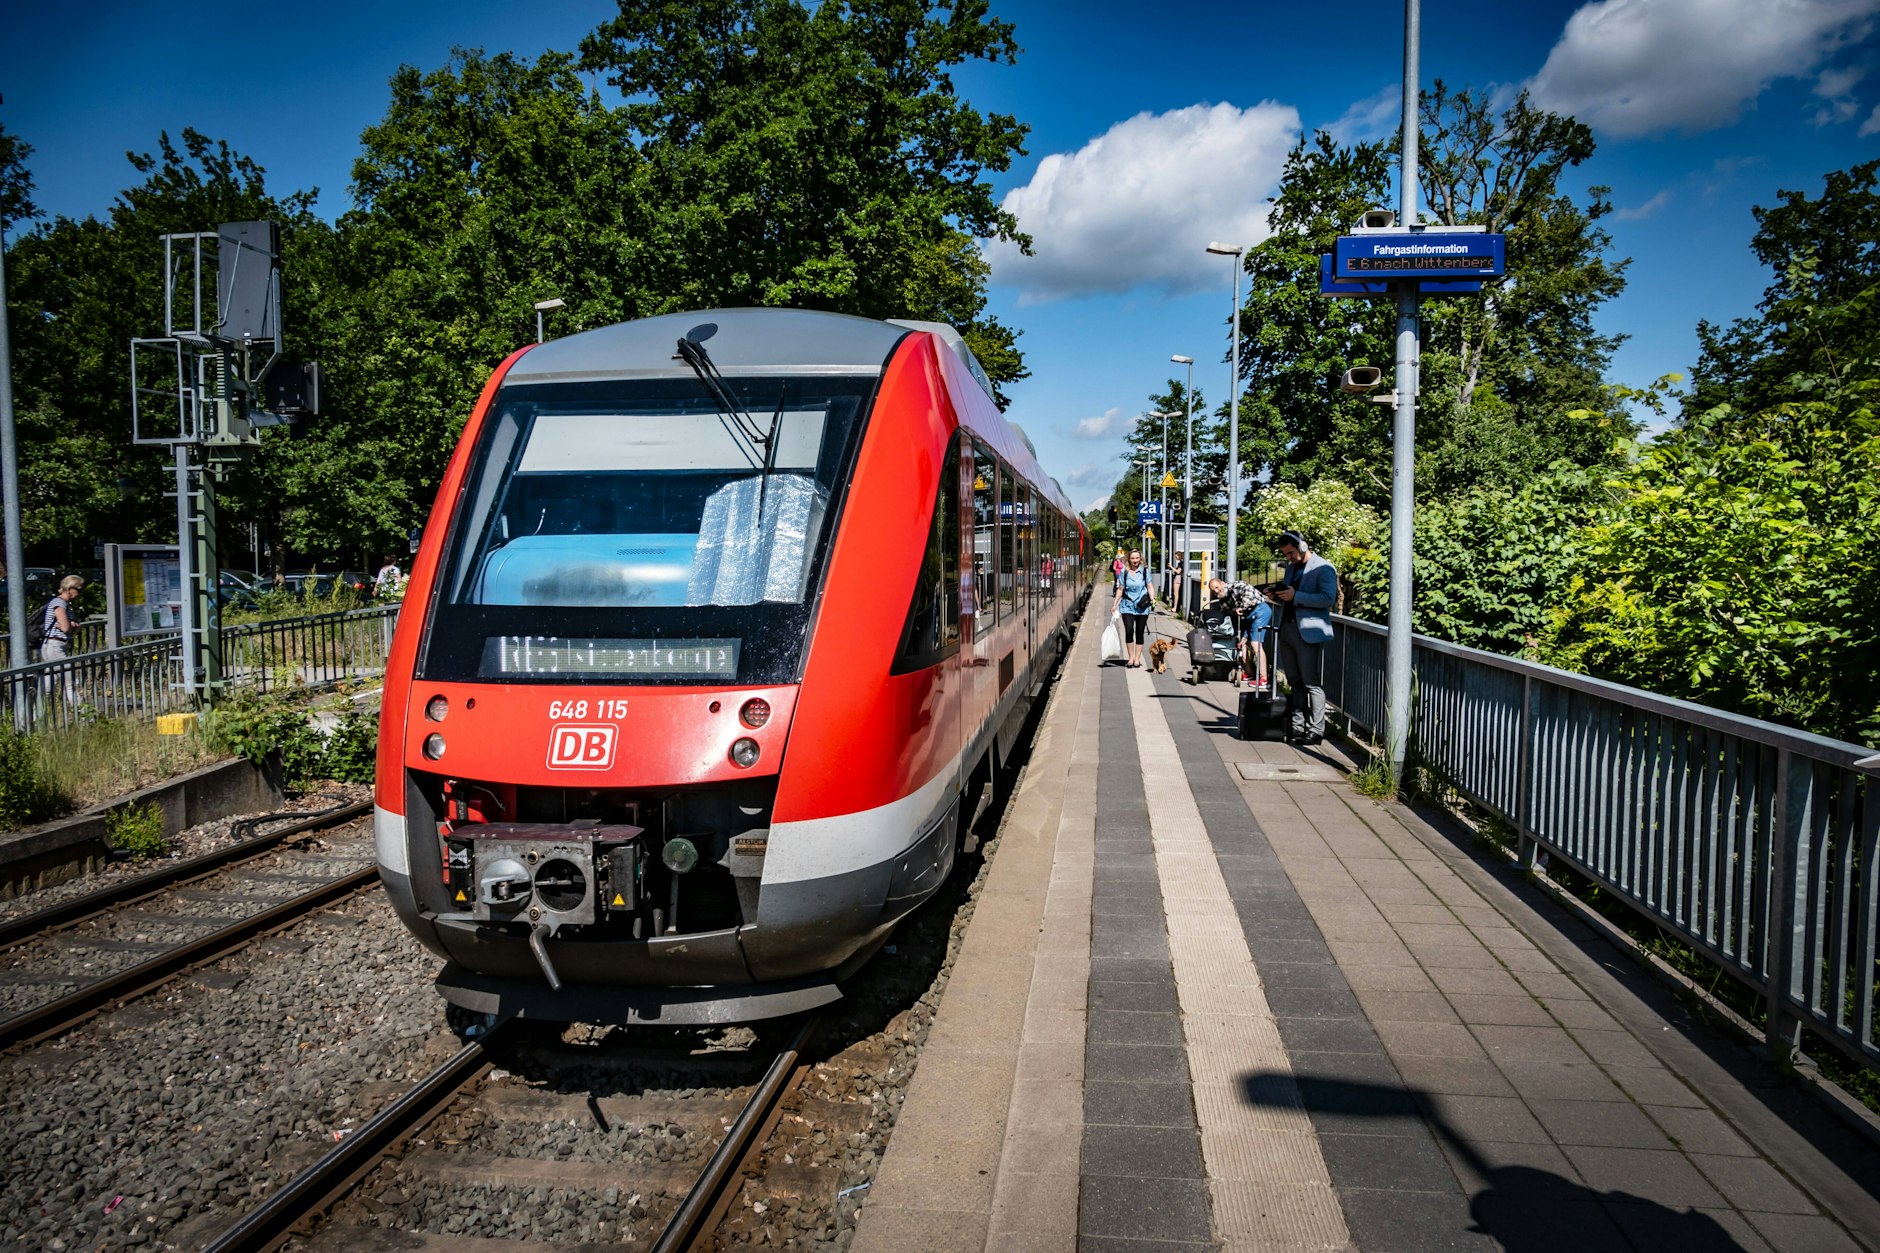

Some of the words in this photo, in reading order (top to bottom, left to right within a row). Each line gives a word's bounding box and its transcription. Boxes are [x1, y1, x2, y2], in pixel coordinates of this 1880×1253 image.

[1373, 245, 1468, 257] Fahrgastinformation
[1360, 257, 1370, 270] 6
[1374, 257, 1411, 269] nach
[1140, 502, 1157, 514] 2a
[549, 699, 588, 720] 648
[597, 699, 628, 720] 115
[556, 731, 608, 762] DB
